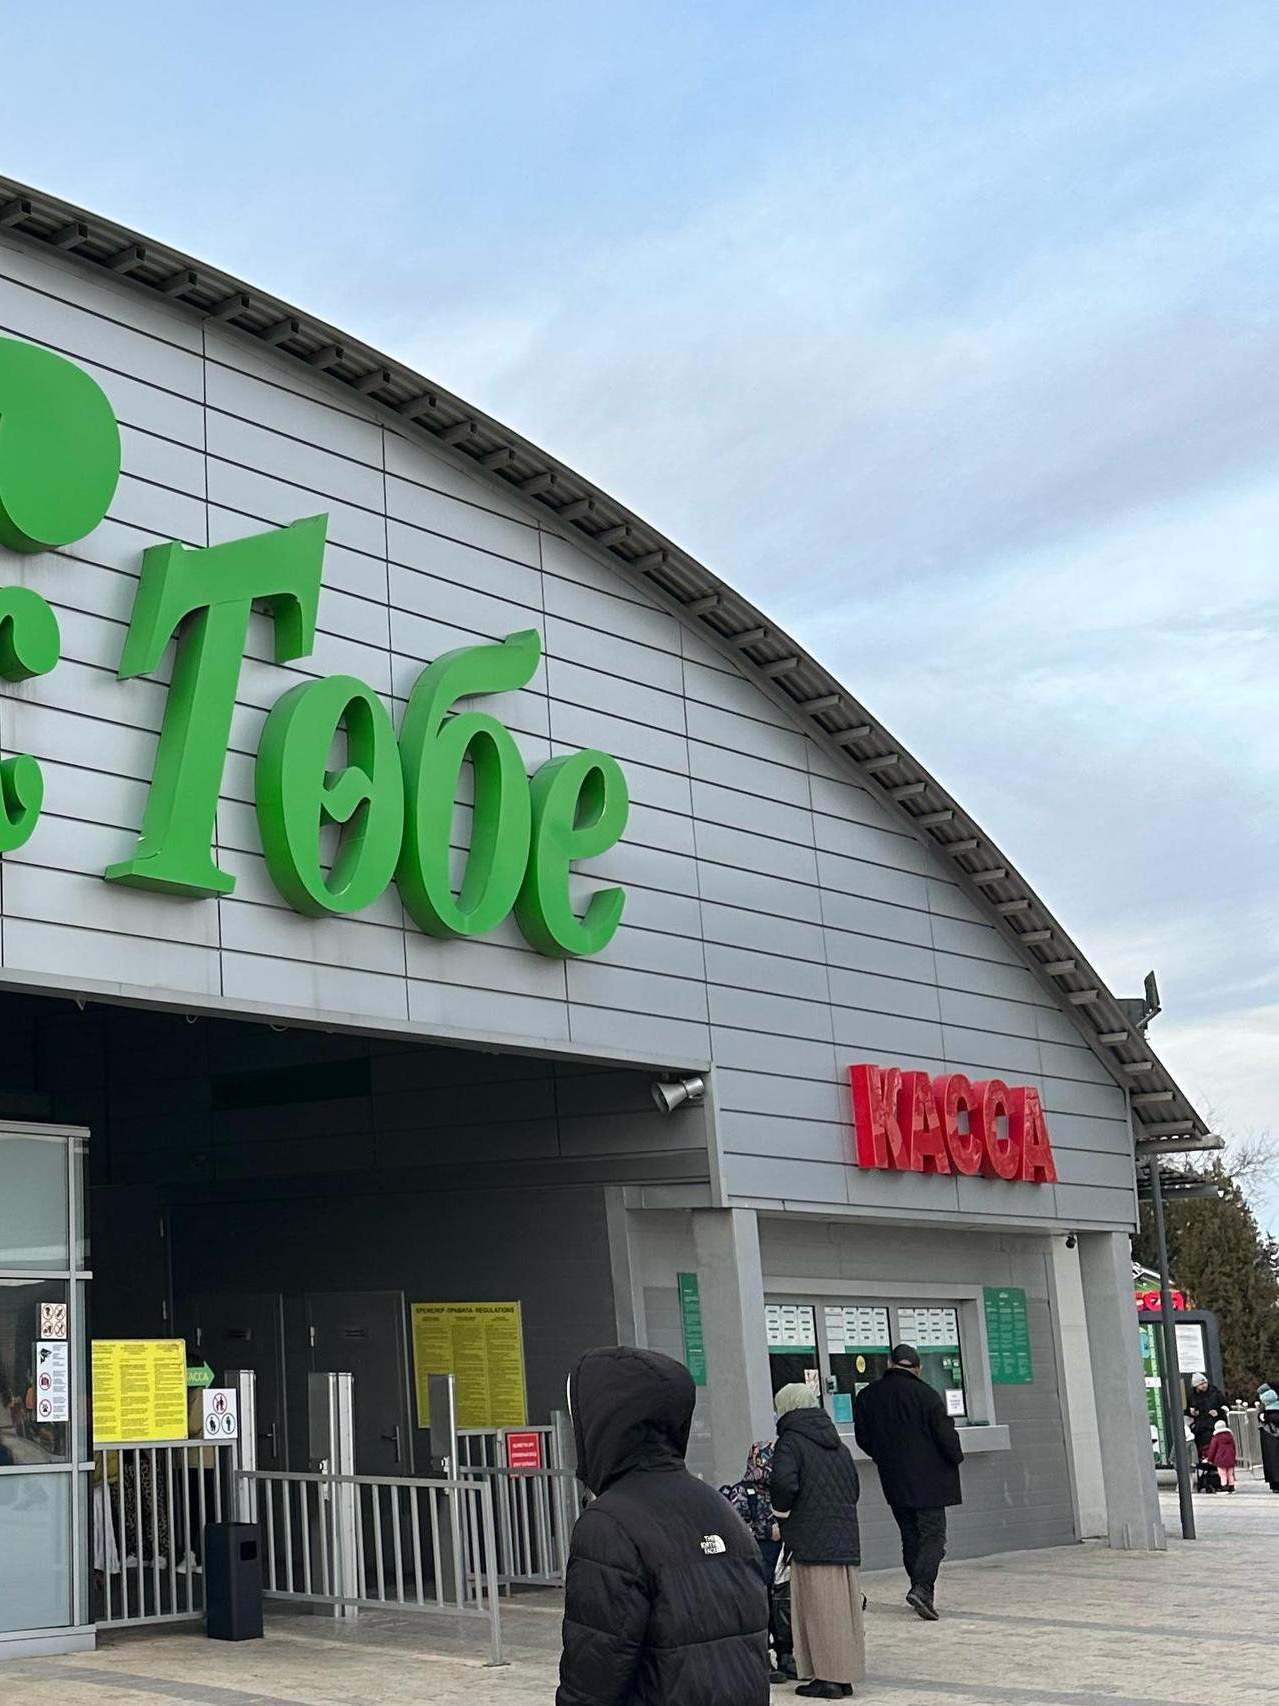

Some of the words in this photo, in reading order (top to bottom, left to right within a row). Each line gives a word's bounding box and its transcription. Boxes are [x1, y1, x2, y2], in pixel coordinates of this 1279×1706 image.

[104, 512, 630, 958] Төбе
[849, 1064, 1058, 1184] КАССА
[186, 1372, 209, 1382] АССА
